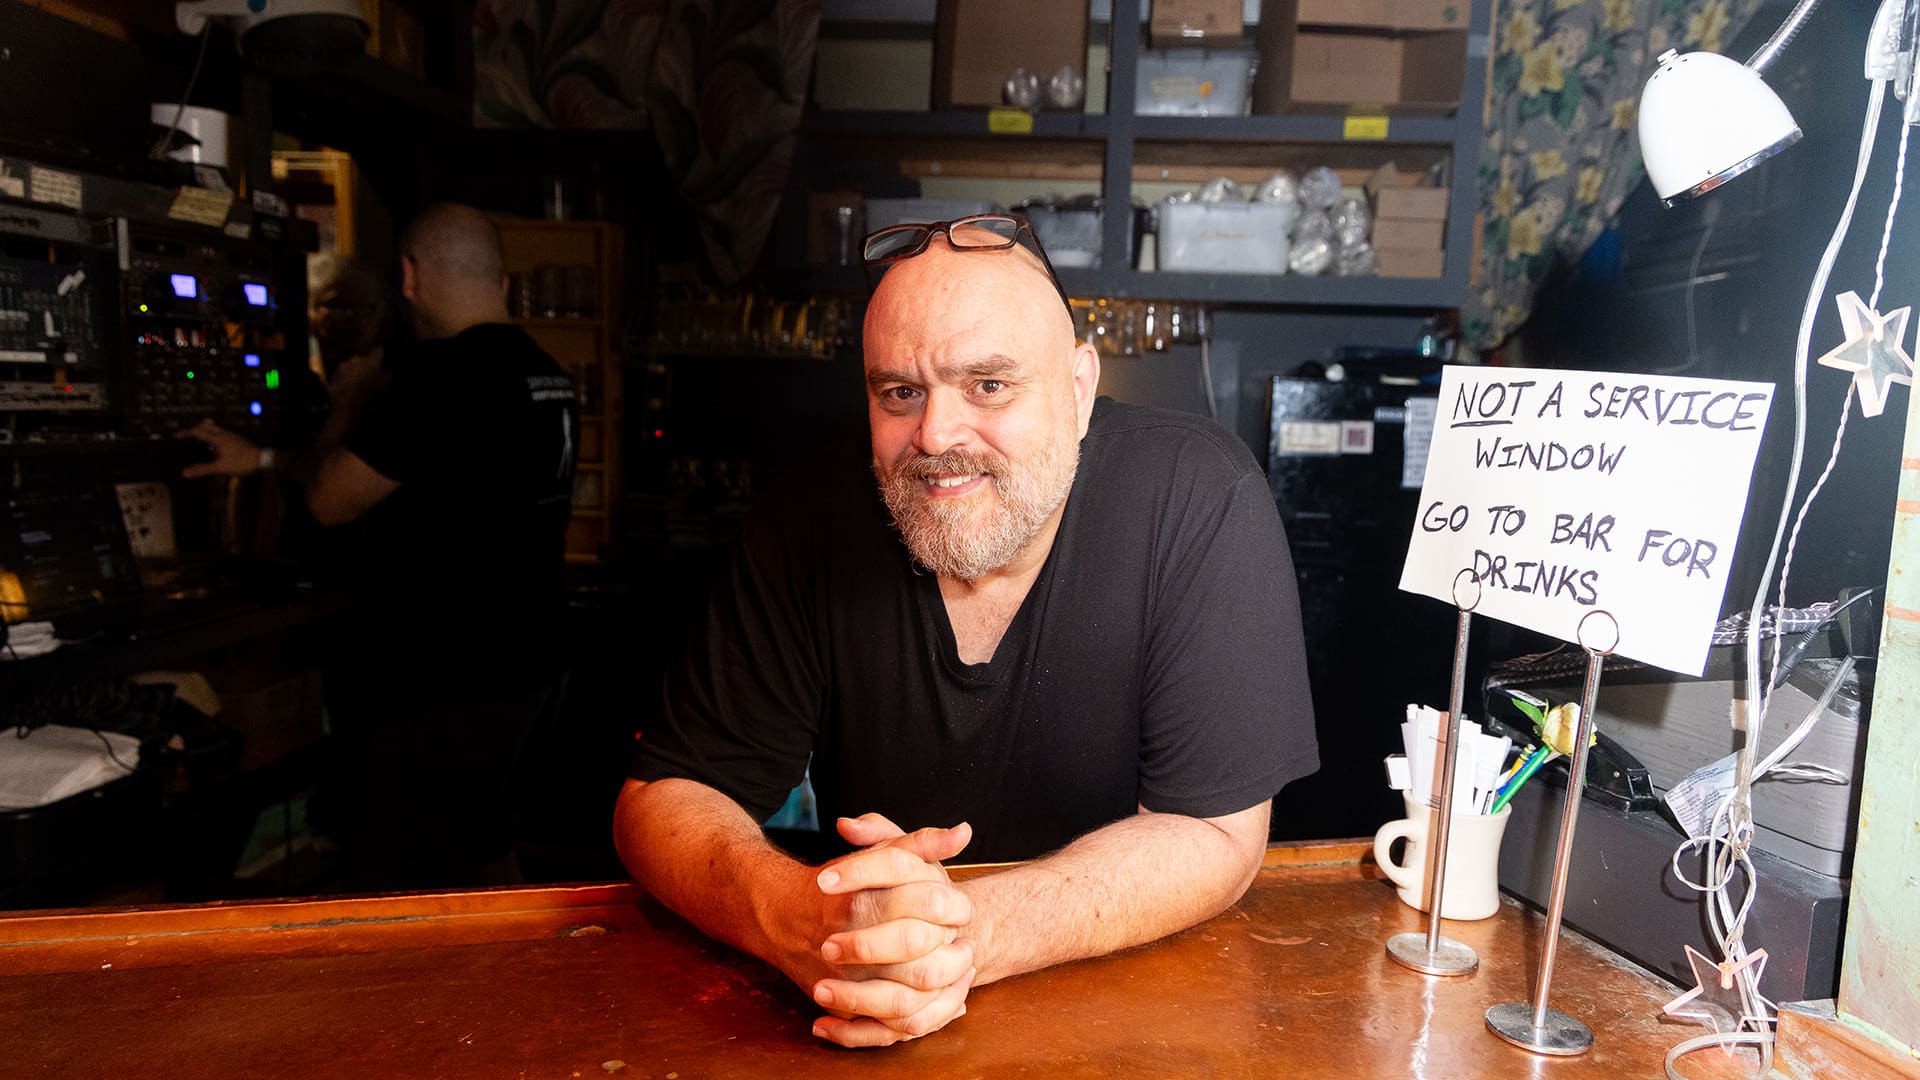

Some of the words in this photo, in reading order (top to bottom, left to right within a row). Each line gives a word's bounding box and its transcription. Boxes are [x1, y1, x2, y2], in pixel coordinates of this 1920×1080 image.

[1452, 381, 1536, 421] NOT
[1537, 381, 1563, 419] A
[1584, 382, 1767, 431] SERVICE
[1475, 437, 1627, 476] WINDOW
[1421, 501, 1470, 533] GO
[1488, 505, 1526, 536] TO
[1550, 512, 1616, 552] BAR
[1638, 529, 1718, 579] FOR
[1470, 549, 1599, 605] DRINKS
